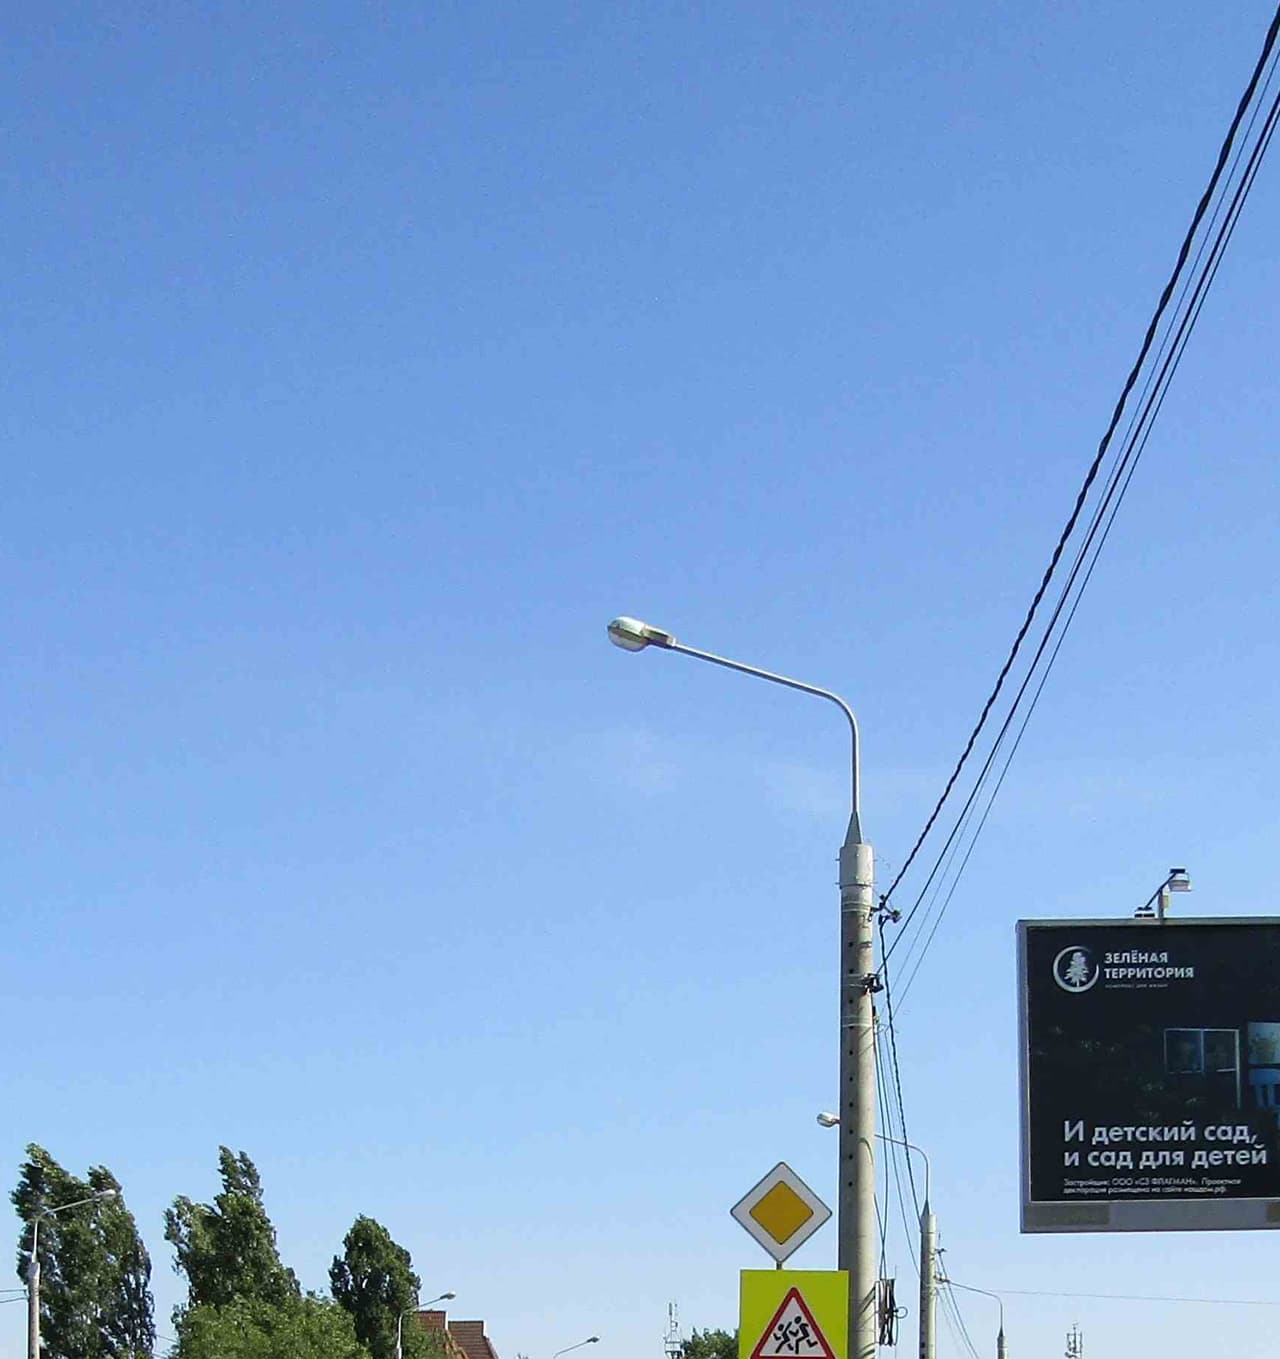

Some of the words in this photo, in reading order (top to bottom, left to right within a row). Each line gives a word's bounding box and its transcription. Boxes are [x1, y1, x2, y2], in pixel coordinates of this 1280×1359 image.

[1104, 950, 1169, 964] ЗЕЛЁНАЯ
[1104, 967, 1195, 979] ТЕРРИТОРИЯ
[1064, 1120, 1084, 1142] И
[1091, 1121, 1196, 1145] детский
[1204, 1124, 1257, 1144] сад,
[1064, 1151, 1080, 1166] и
[1087, 1150, 1133, 1169] сад
[1139, 1150, 1184, 1169] для
[1191, 1144, 1267, 1168] детей
